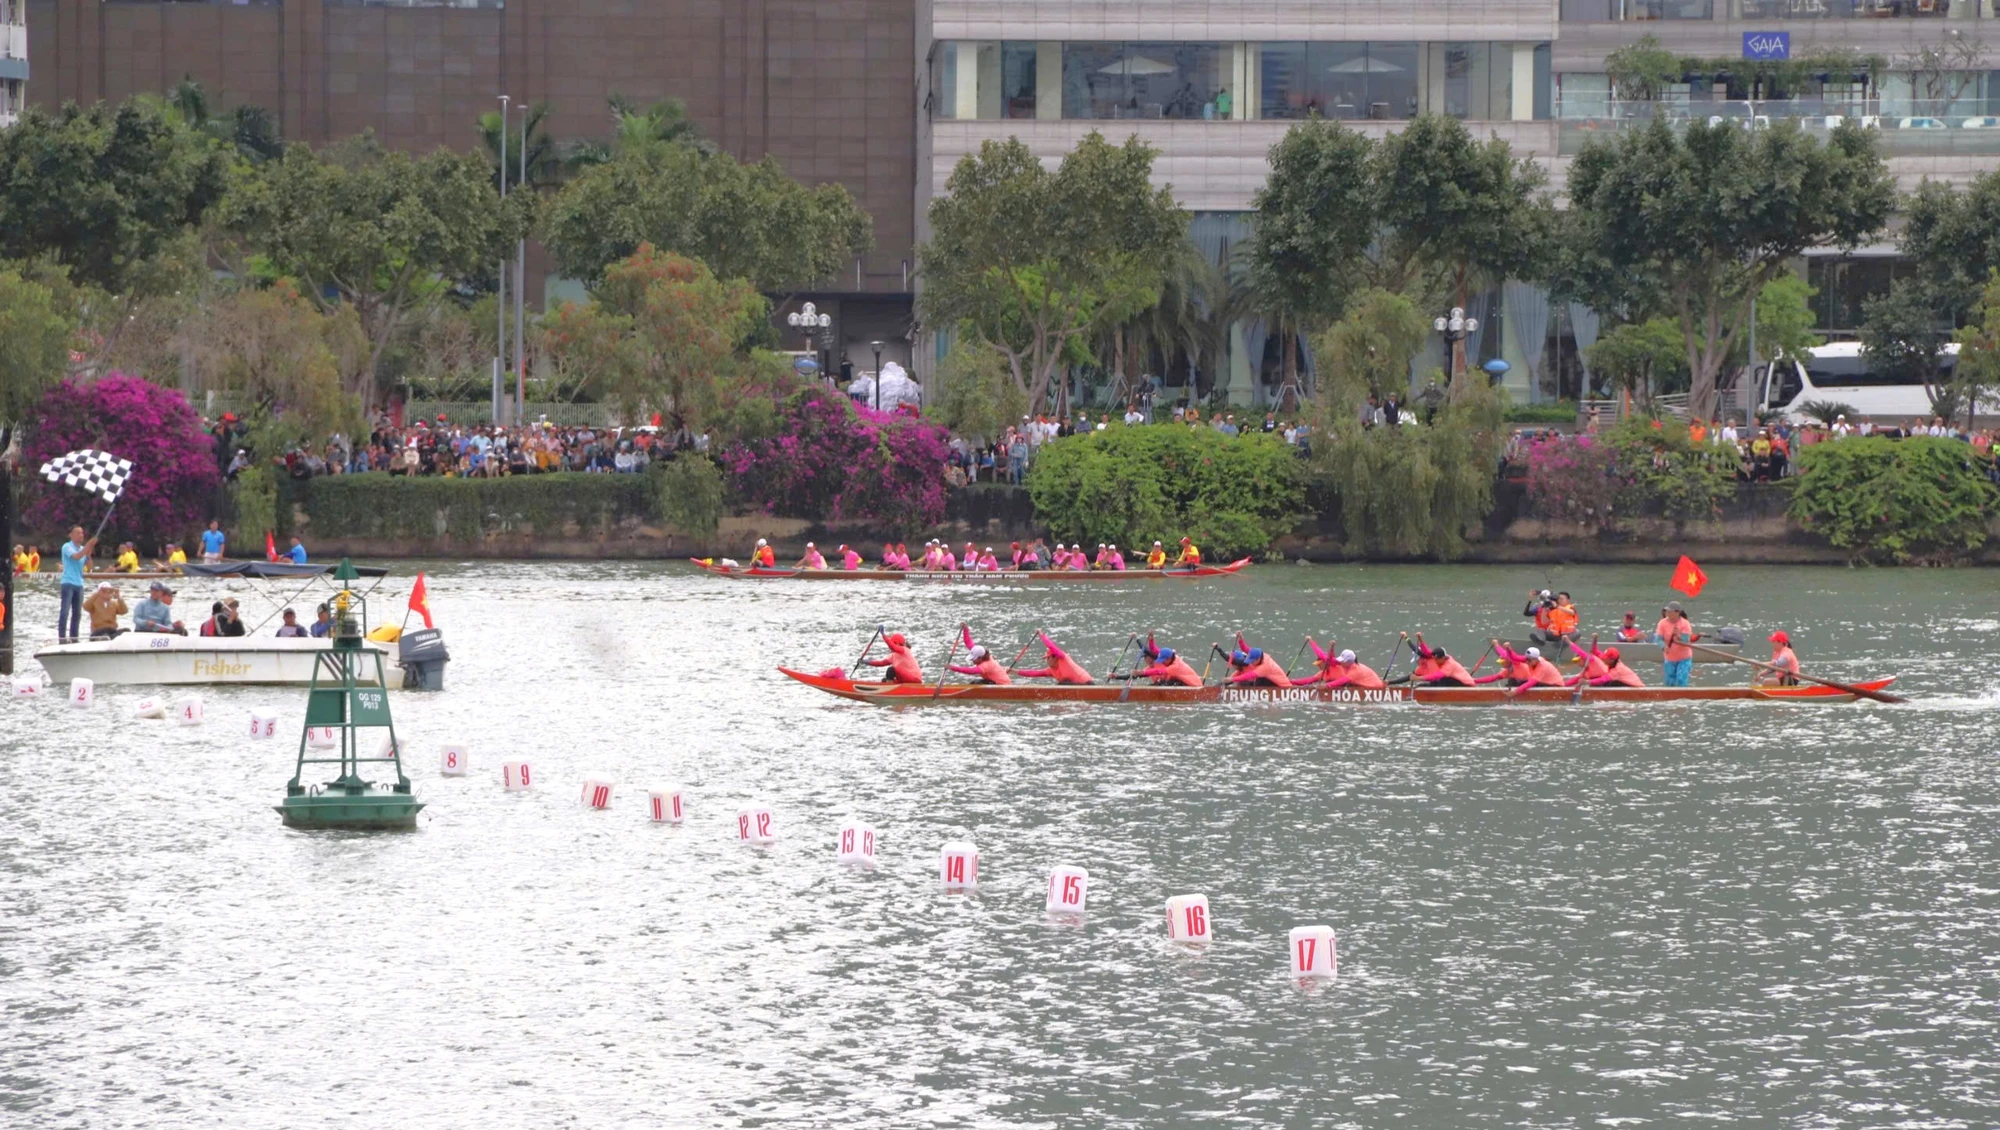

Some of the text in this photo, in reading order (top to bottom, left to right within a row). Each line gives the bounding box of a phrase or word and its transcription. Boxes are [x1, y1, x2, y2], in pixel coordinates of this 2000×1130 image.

[1748, 35, 1784, 53] GAIA
[150, 638, 170, 648] 868
[415, 632, 437, 642] YAMAHA
[193, 659, 252, 676] Fisher
[77, 687, 86, 701] 2
[1222, 689, 1270, 701] TRUNG
[184, 706, 193, 720] 4
[265, 721, 275, 737] 5
[447, 752, 457, 768] 8
[520, 764, 531, 786] 9
[591, 785, 609, 808] 10
[653, 797, 662, 819] 11
[738, 814, 750, 840] 12
[756, 812, 773, 837] 12
[841, 828, 855, 854] 13
[863, 831, 874, 856] 13
[947, 856, 964, 883] 14
[1062, 875, 1082, 905] 15
[1185, 905, 1206, 937] 16
[1297, 938, 1317, 971] 17
